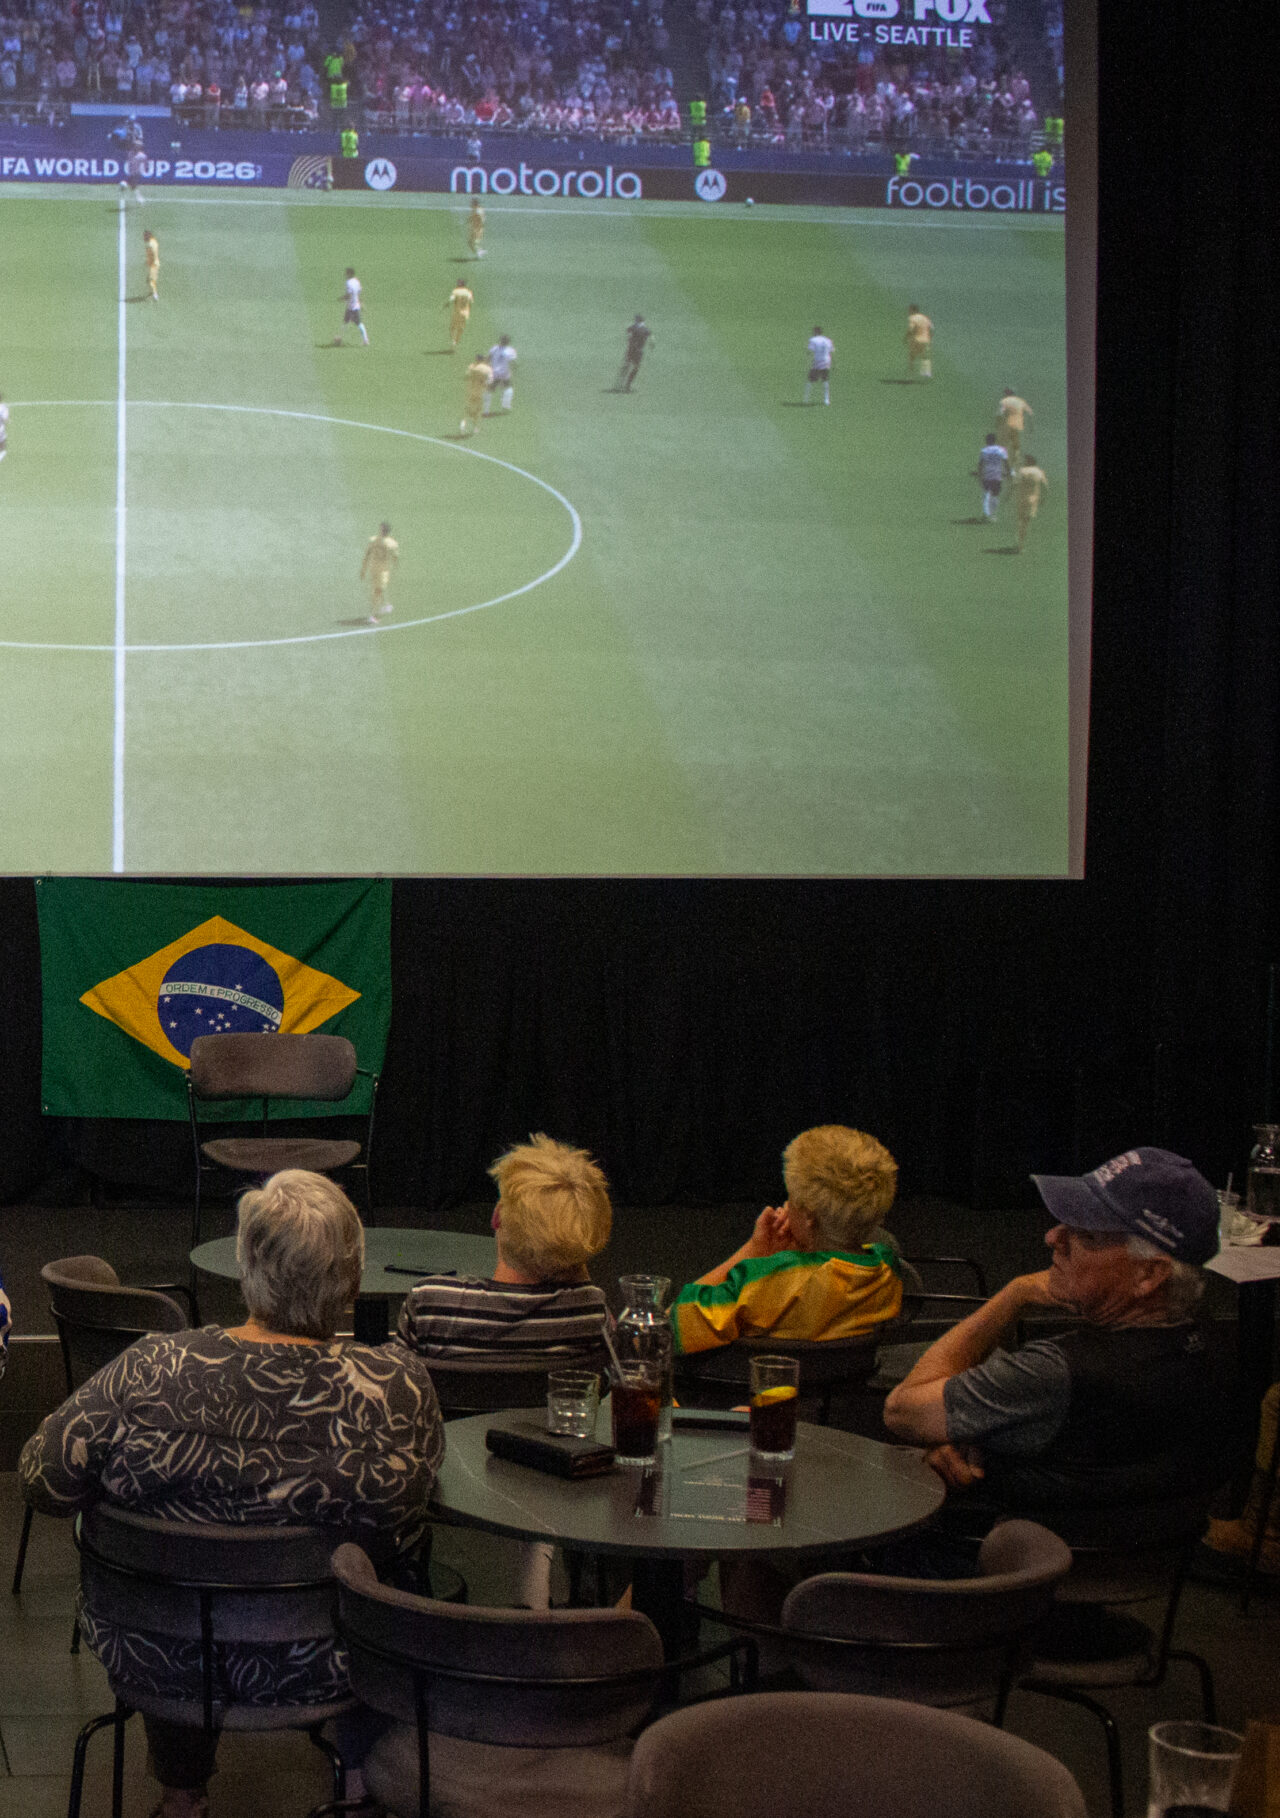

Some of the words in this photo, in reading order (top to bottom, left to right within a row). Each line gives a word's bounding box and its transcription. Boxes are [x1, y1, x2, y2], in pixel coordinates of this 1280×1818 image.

[914, 0, 993, 24] FOX
[810, 21, 860, 43] LIVE
[874, 24, 973, 48] SEATTLE
[34, 157, 120, 177] WORLD
[174, 160, 256, 180] 2026
[450, 162, 643, 199] motorola
[886, 176, 1034, 210] football
[1043, 181, 1066, 211] is
[165, 983, 208, 994] ORDEM
[216, 990, 279, 1021] PROGRESSO
